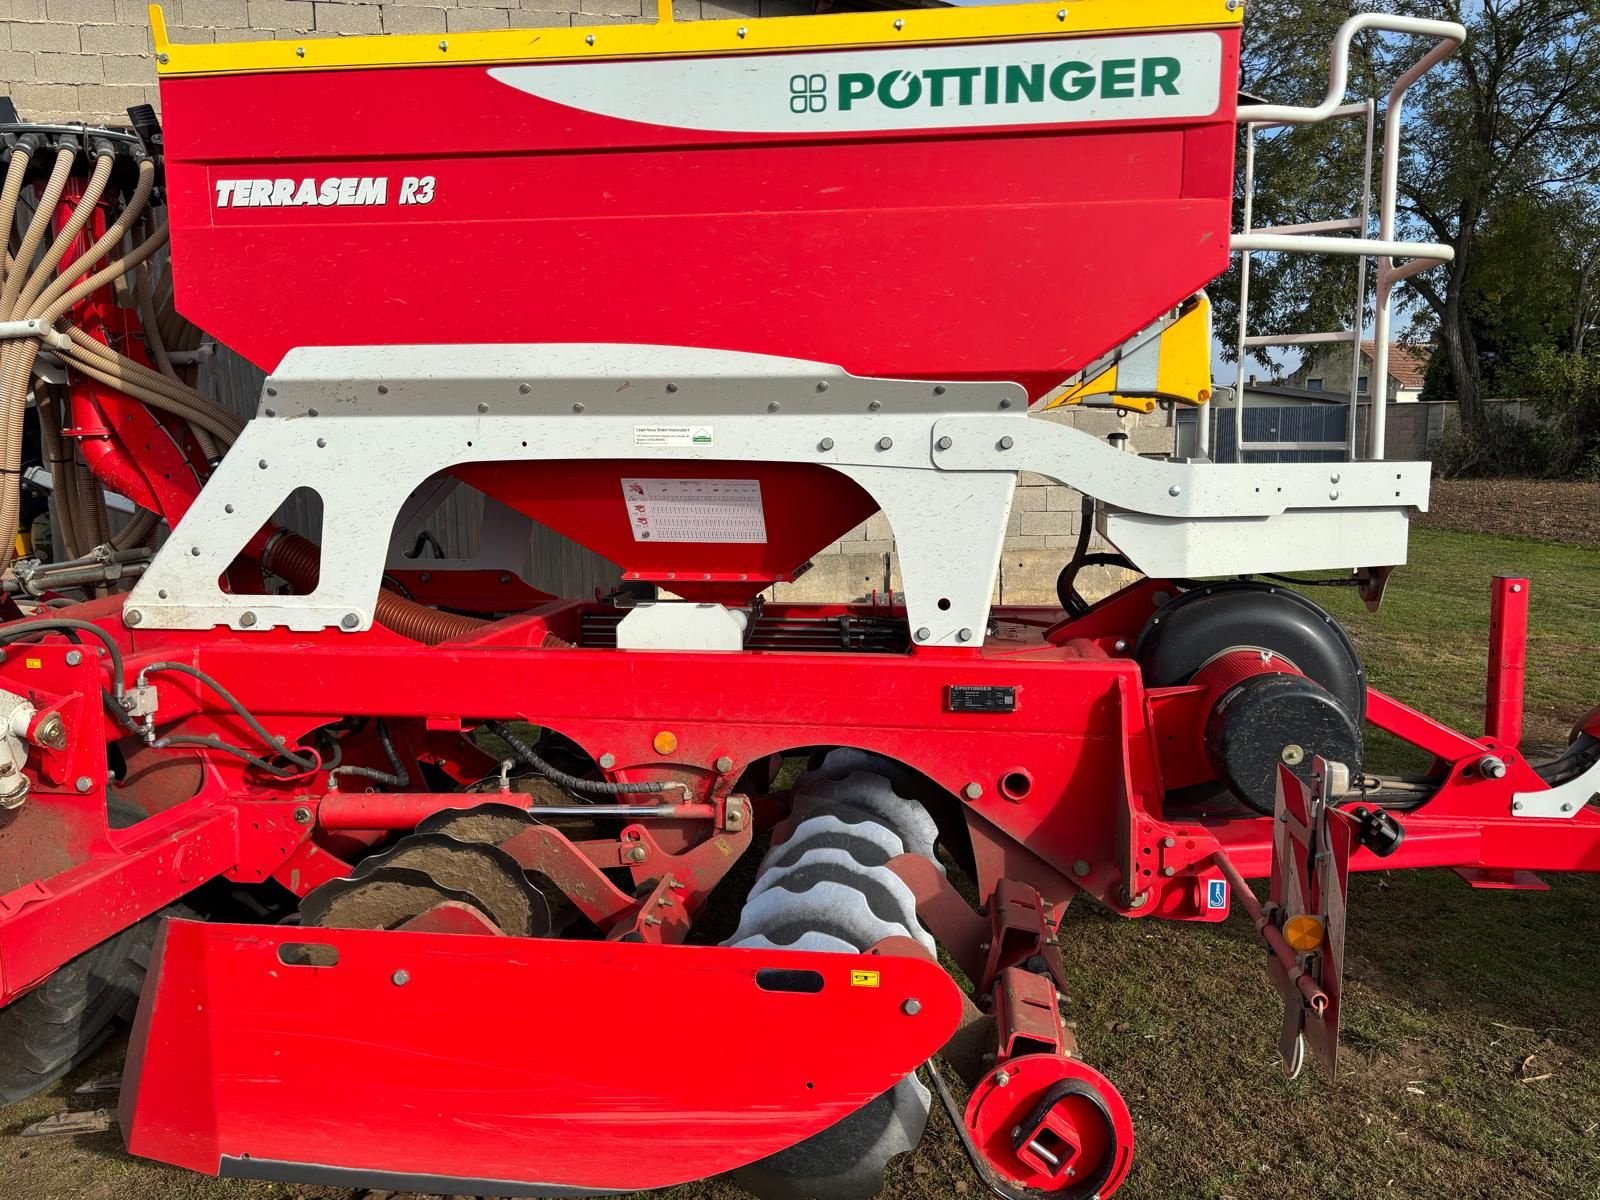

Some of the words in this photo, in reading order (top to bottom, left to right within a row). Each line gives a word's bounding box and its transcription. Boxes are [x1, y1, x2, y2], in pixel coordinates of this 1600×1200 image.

[838, 56, 1181, 111] PÖTTINGER
[216, 177, 388, 207] TERRASEM
[399, 176, 436, 205] R3
